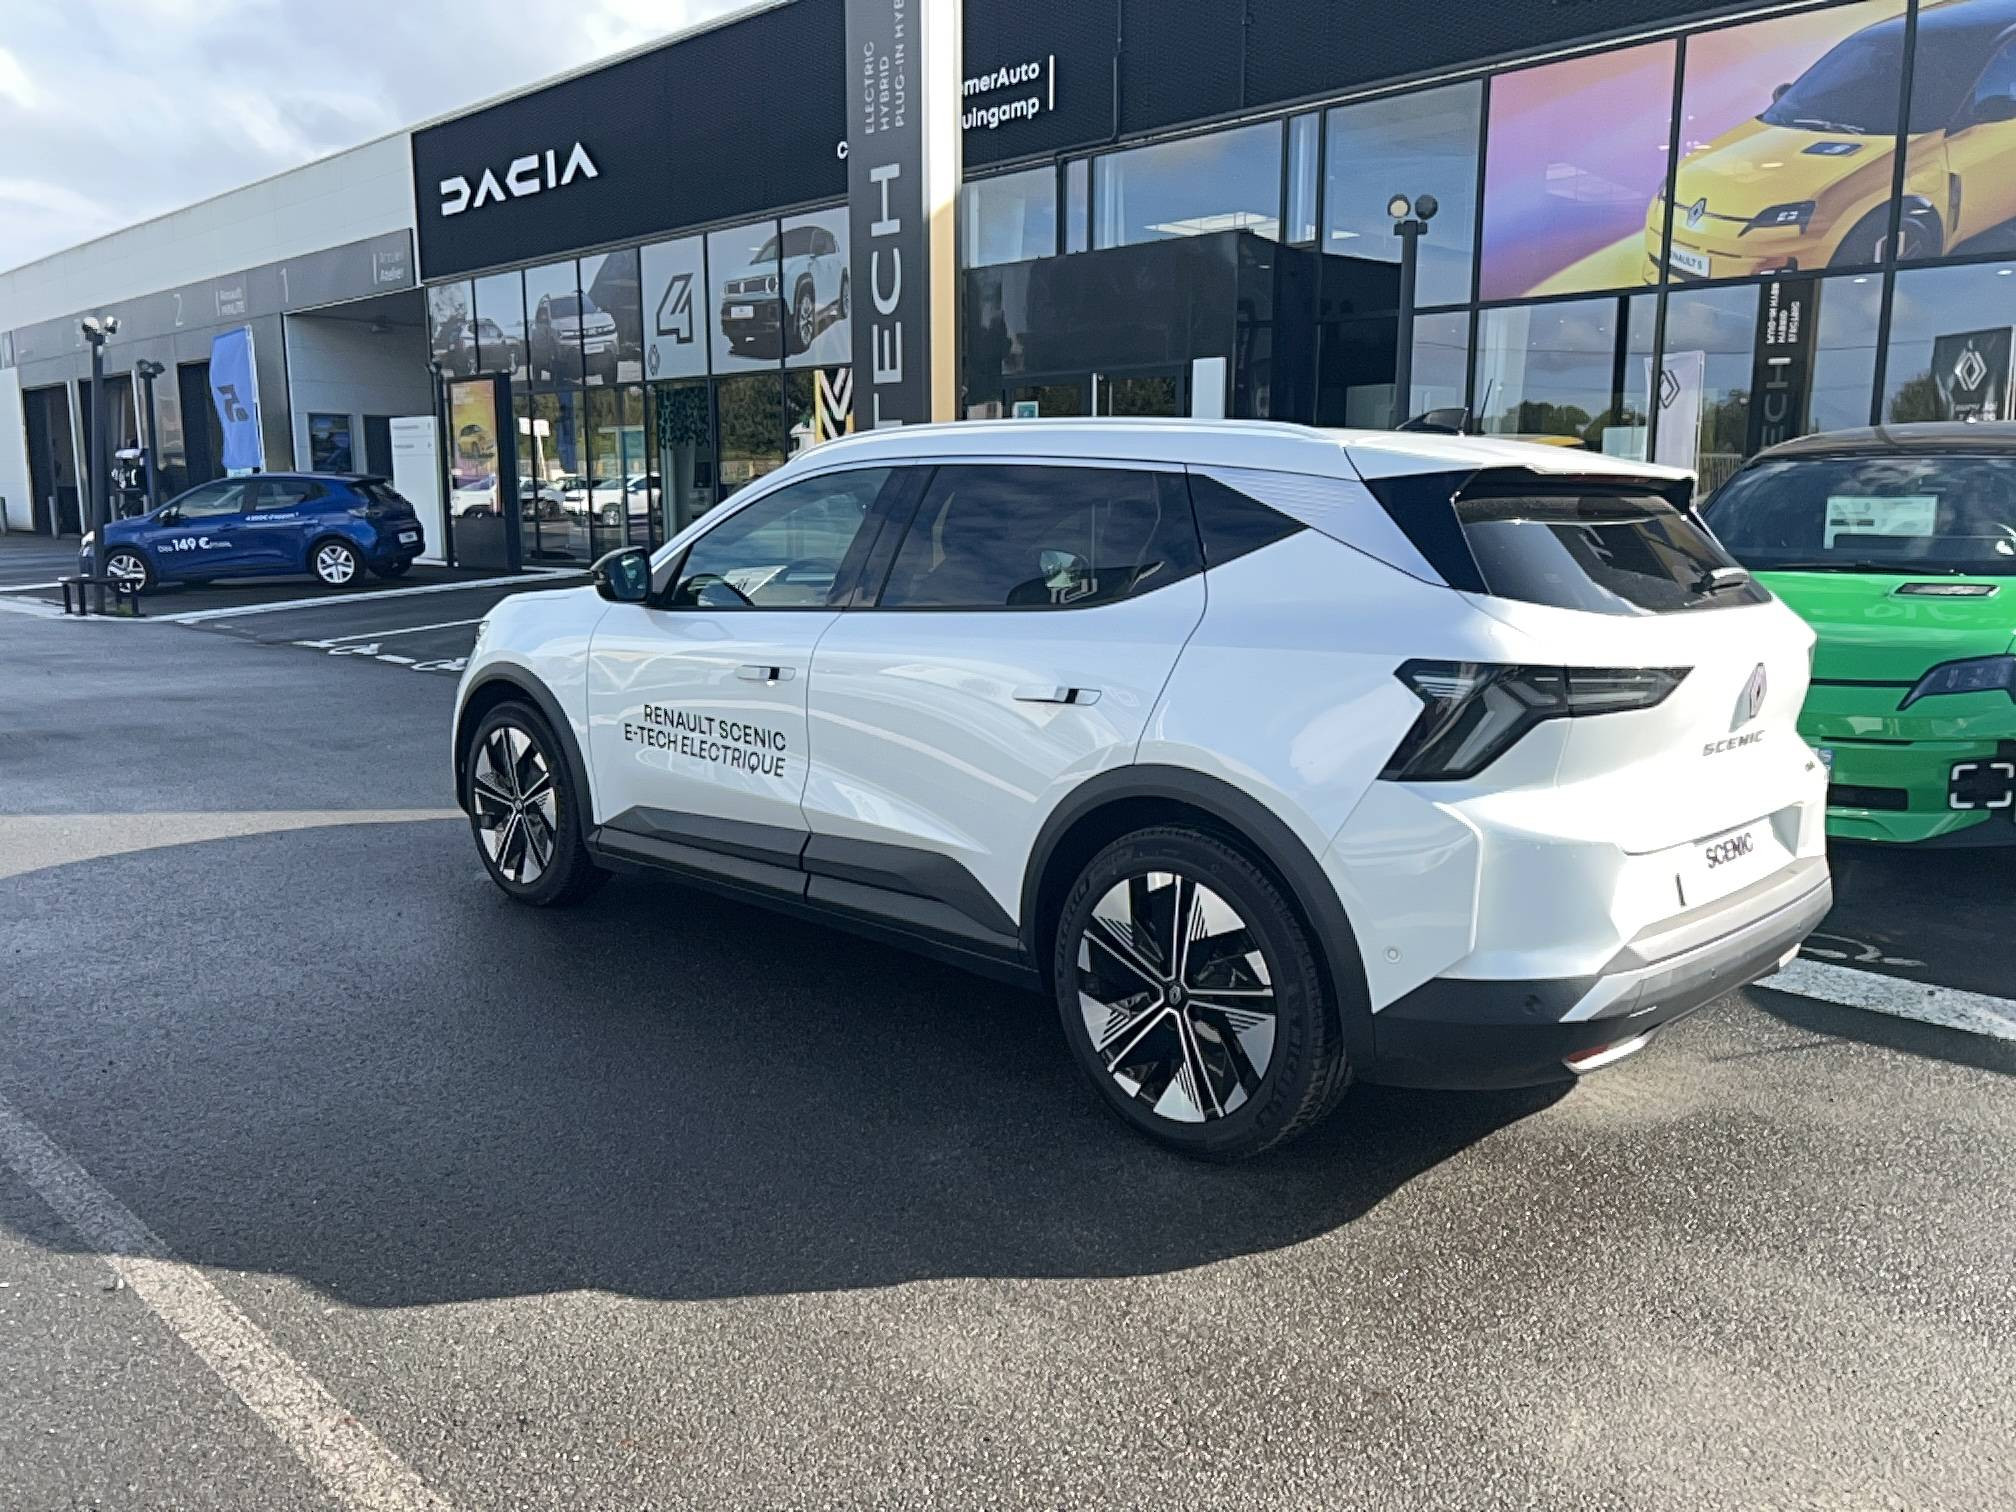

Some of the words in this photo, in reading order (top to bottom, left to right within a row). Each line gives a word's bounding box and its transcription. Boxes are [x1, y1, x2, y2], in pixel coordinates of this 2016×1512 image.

[863, 41, 875, 134] ELECTRIC
[879, 56, 889, 131] HYBRID
[894, 43, 905, 127] PLUG-IN
[961, 62, 1040, 97] merAuto
[961, 97, 1040, 129] uingamp
[440, 142, 599, 217] DACIA
[171, 537, 197, 552] 149
[624, 722, 678, 753] E-TECH
[681, 736, 787, 777] ELECTRIQUE
[643, 704, 715, 737] RENAULT
[719, 719, 787, 752] SCENIC
[1702, 729, 1766, 757] SCENIC
[1705, 832, 1754, 869] SCENIC
